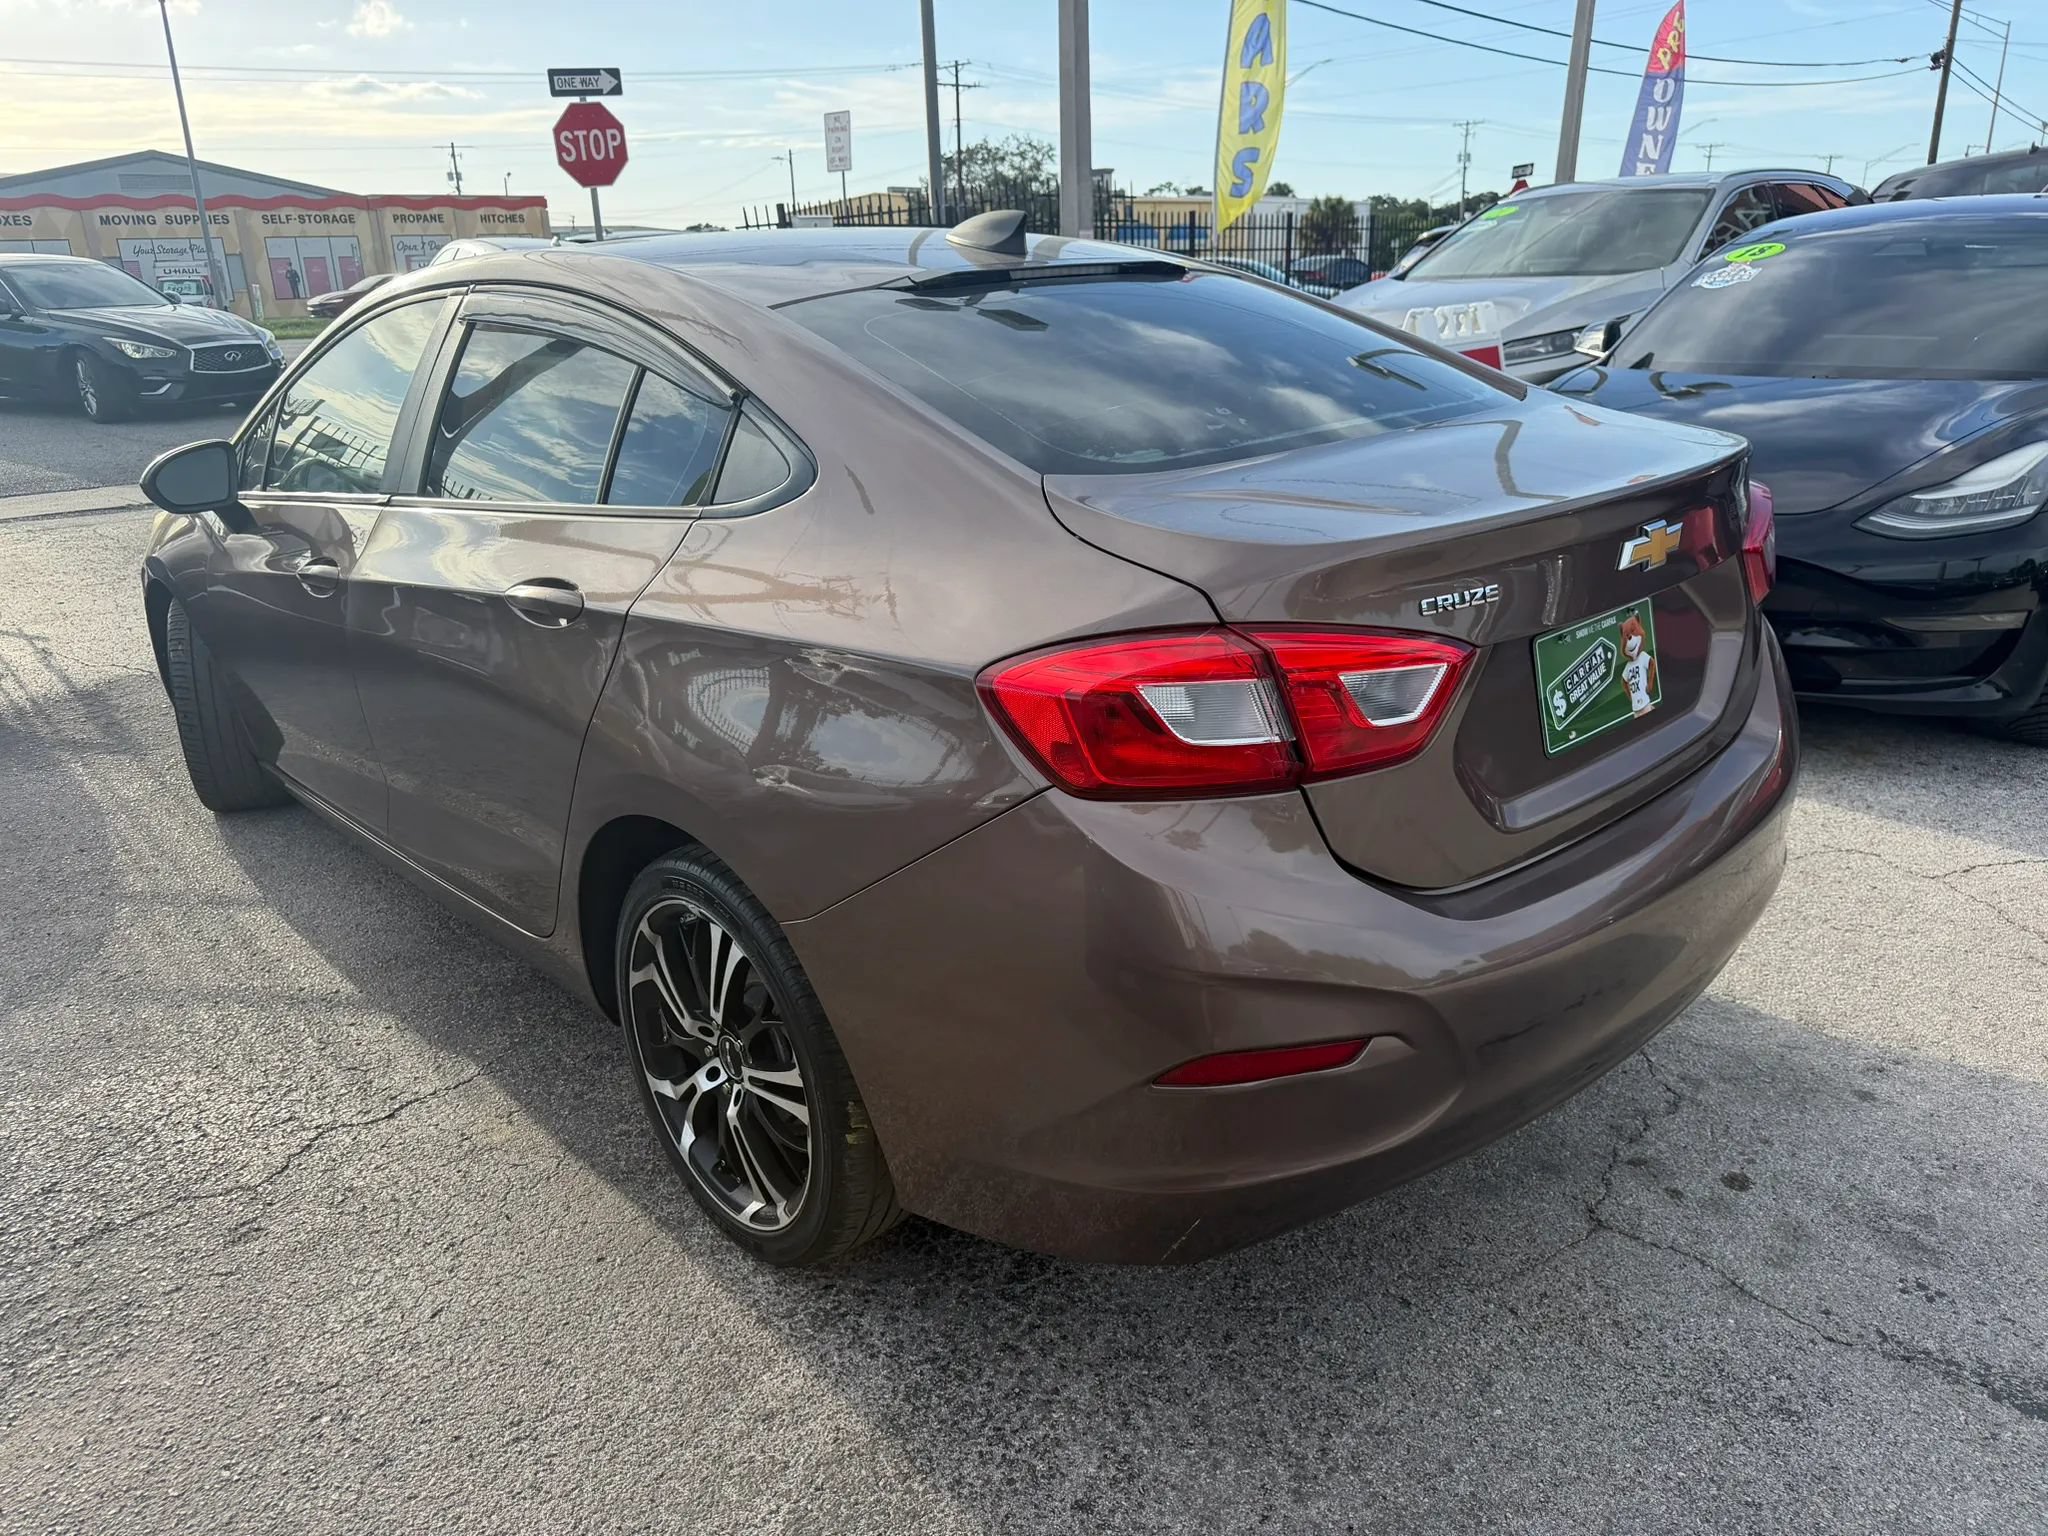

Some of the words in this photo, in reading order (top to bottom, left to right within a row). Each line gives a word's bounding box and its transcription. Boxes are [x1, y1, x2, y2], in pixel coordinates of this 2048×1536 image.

[556, 77, 578, 89] ONE
[579, 76, 601, 88] WAY
[1634, 77, 1676, 176] OWNE
[559, 128, 622, 162] STOP
[0, 214, 33, 226] XES
[98, 214, 157, 226] MOVING
[164, 214, 230, 225] SUPPIES
[261, 213, 356, 225] SELF-STORAGE
[392, 213, 445, 224] PROPANE
[479, 213, 526, 224] HITCHES
[156, 243, 189, 256] Storage
[190, 243, 206, 254] Pla
[396, 240, 419, 254] Open
[163, 267, 201, 275] U-HAUL
[1419, 583, 1499, 616] CRUZE
[1565, 645, 1605, 690] CARFAX
[1628, 665, 1640, 682] CAR
[1569, 679, 1589, 703] GREAT
[1587, 662, 1607, 686] VALUE
[1629, 680, 1641, 694] FOX
[1553, 689, 1567, 718] $
